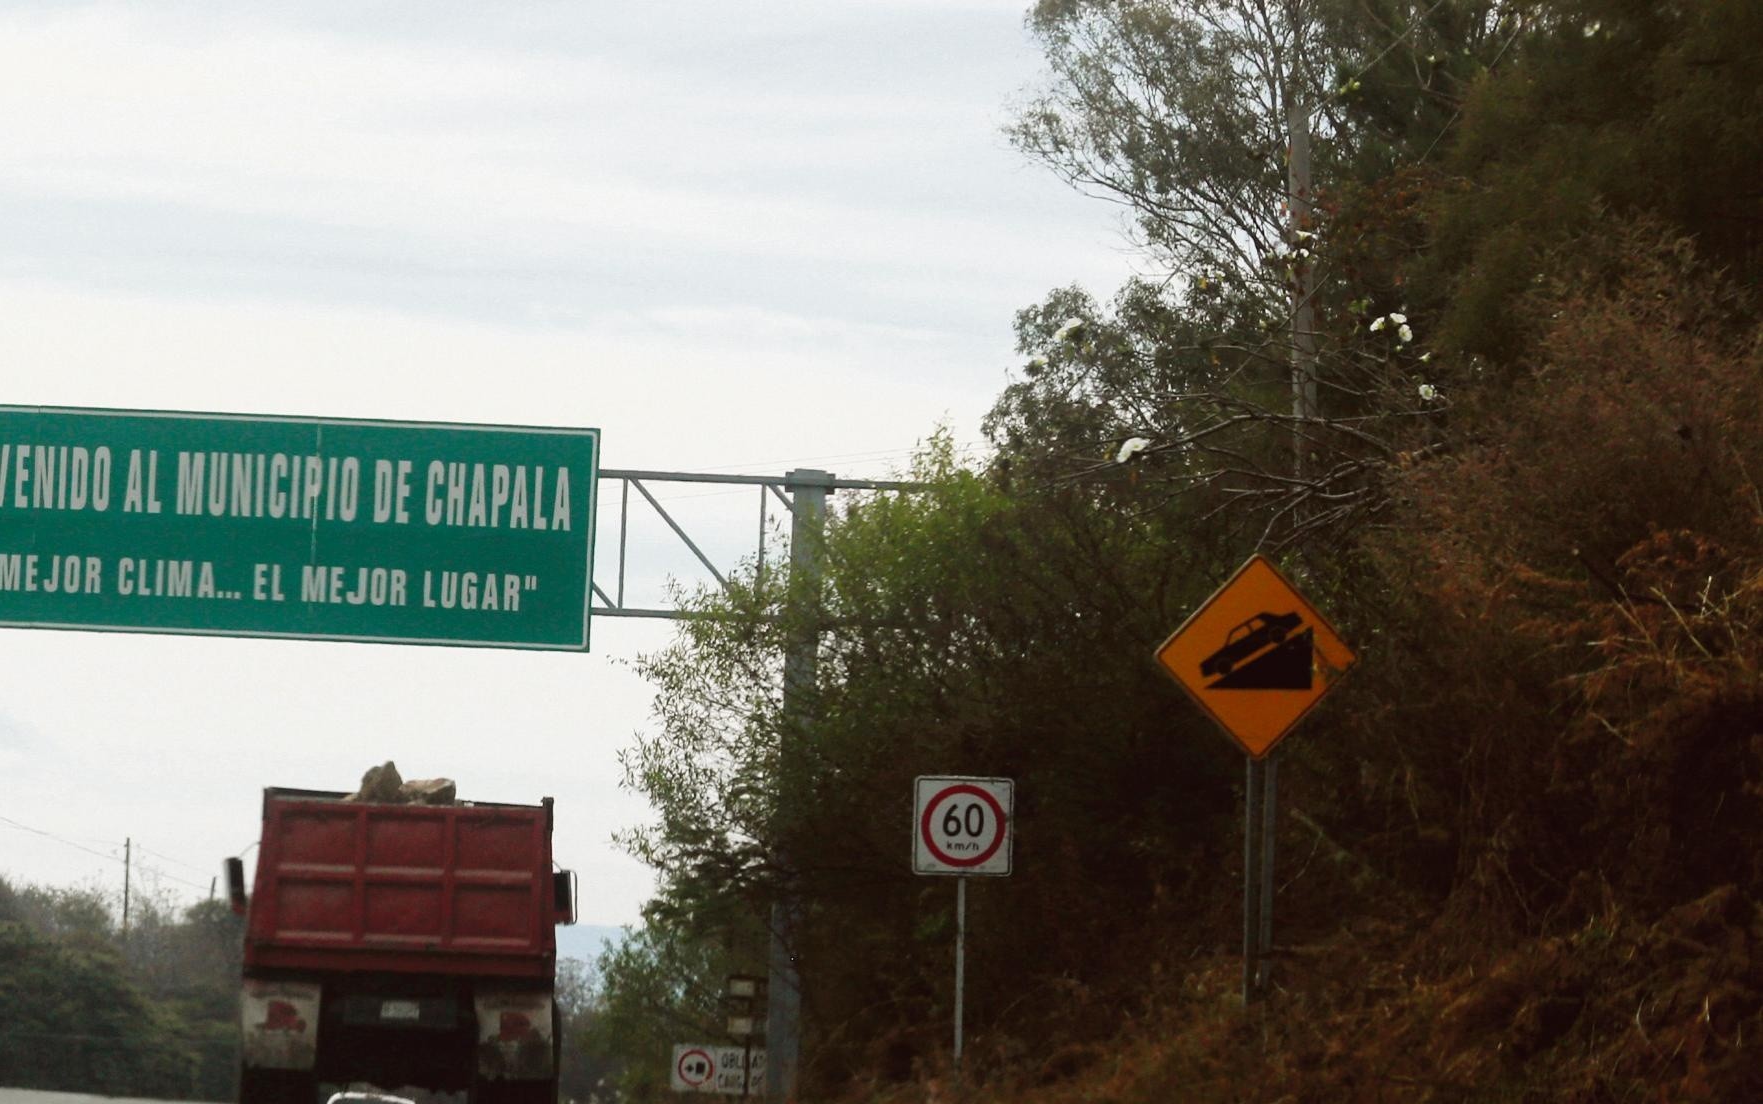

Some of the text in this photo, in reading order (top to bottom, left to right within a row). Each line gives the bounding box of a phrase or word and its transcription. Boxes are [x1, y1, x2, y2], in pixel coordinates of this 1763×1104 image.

[123, 449, 163, 513] AL
[176, 451, 359, 522] MUNICIPIO
[373, 459, 413, 524] DE
[425, 460, 571, 531] CHAPALA
[118, 557, 242, 599] CLIMA...
[253, 563, 285, 601] EL
[301, 565, 407, 606] MEJOR
[423, 570, 538, 611] LUGAR"
[942, 803, 984, 838] 60
[946, 841, 980, 851] km/h
